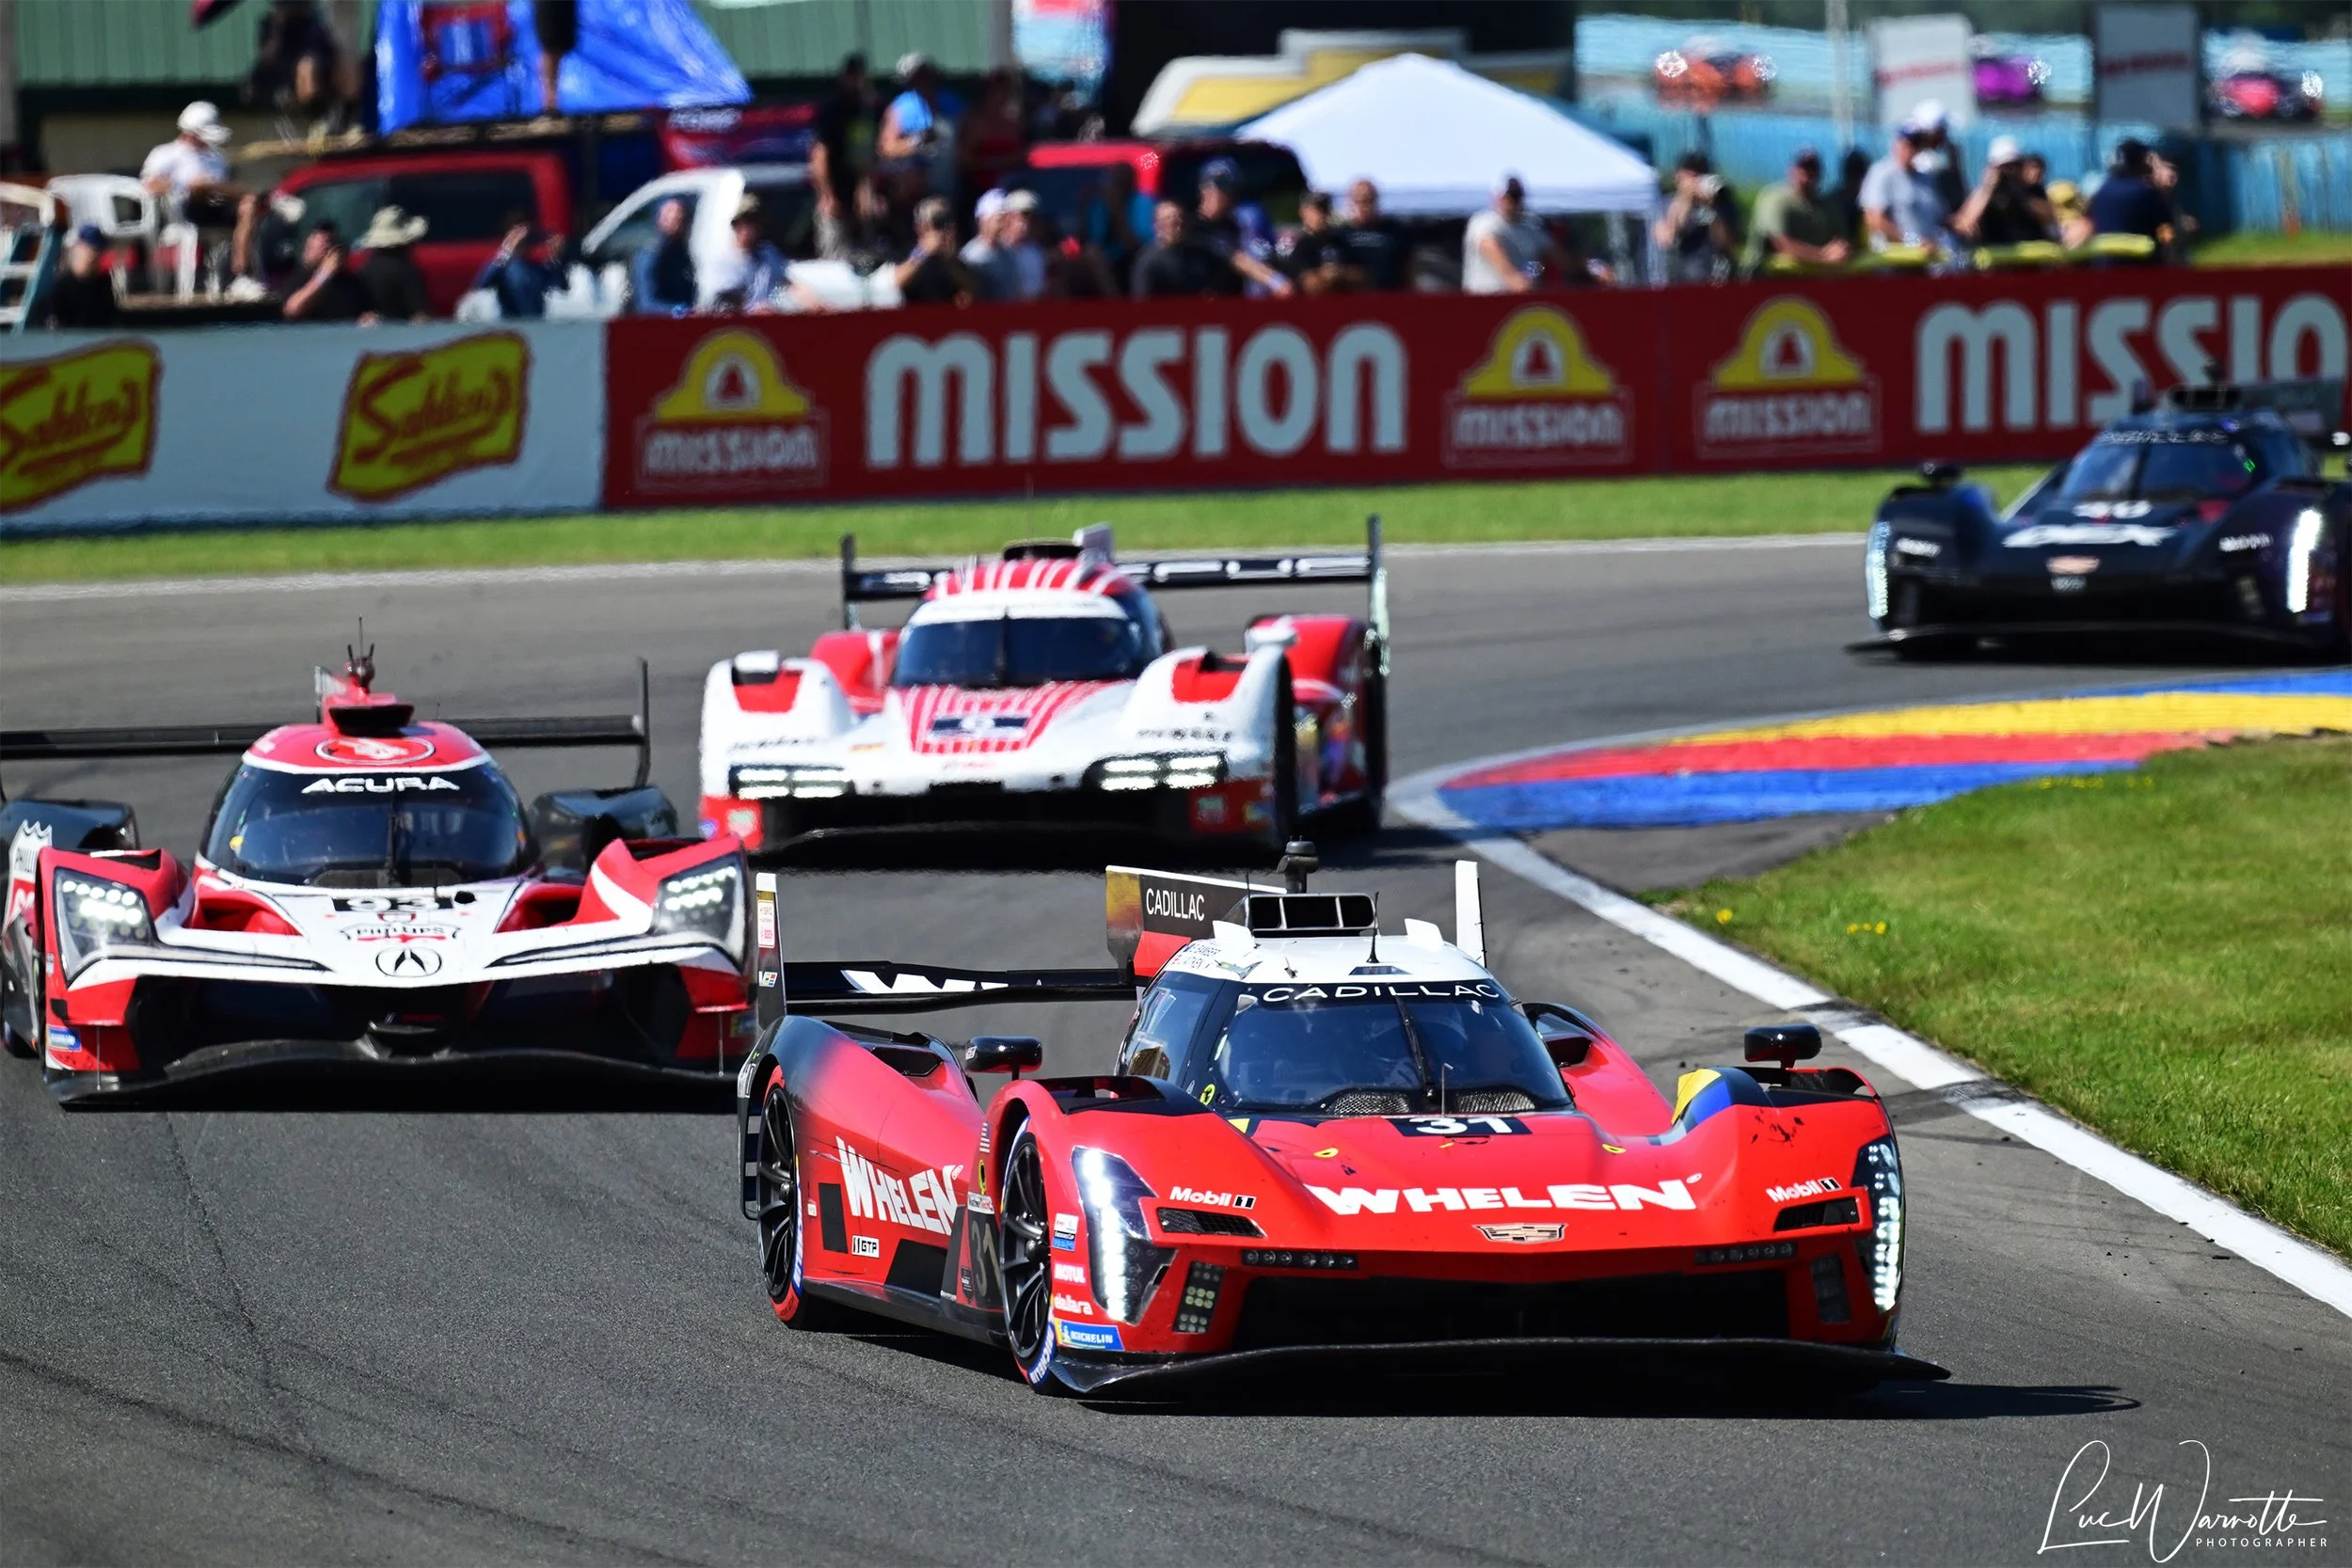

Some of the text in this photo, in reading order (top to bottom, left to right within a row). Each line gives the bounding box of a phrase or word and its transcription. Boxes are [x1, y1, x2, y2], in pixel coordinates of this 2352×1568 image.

[866, 323, 1406, 466] MISSION
[1452, 404, 1624, 451] MISSION
[1705, 392, 1871, 439] MISSION
[644, 425, 818, 472] MISSION
[301, 776, 460, 794] ACURA
[1146, 888, 1204, 921] CADILLAC
[1263, 985, 1500, 1002] CADILLAC
[1409, 1117, 1512, 1134] 31
[835, 1135, 958, 1236] WHELEN
[1303, 1180, 1696, 1215] WHELEN
[1766, 1180, 1822, 1202] Mobil
[1170, 1186, 1255, 1210] Mobil 1
[861, 1241, 878, 1254] GTP
[1055, 1263, 1086, 1284] MOTUL
[1070, 1330, 1114, 1344] MICHELIN
